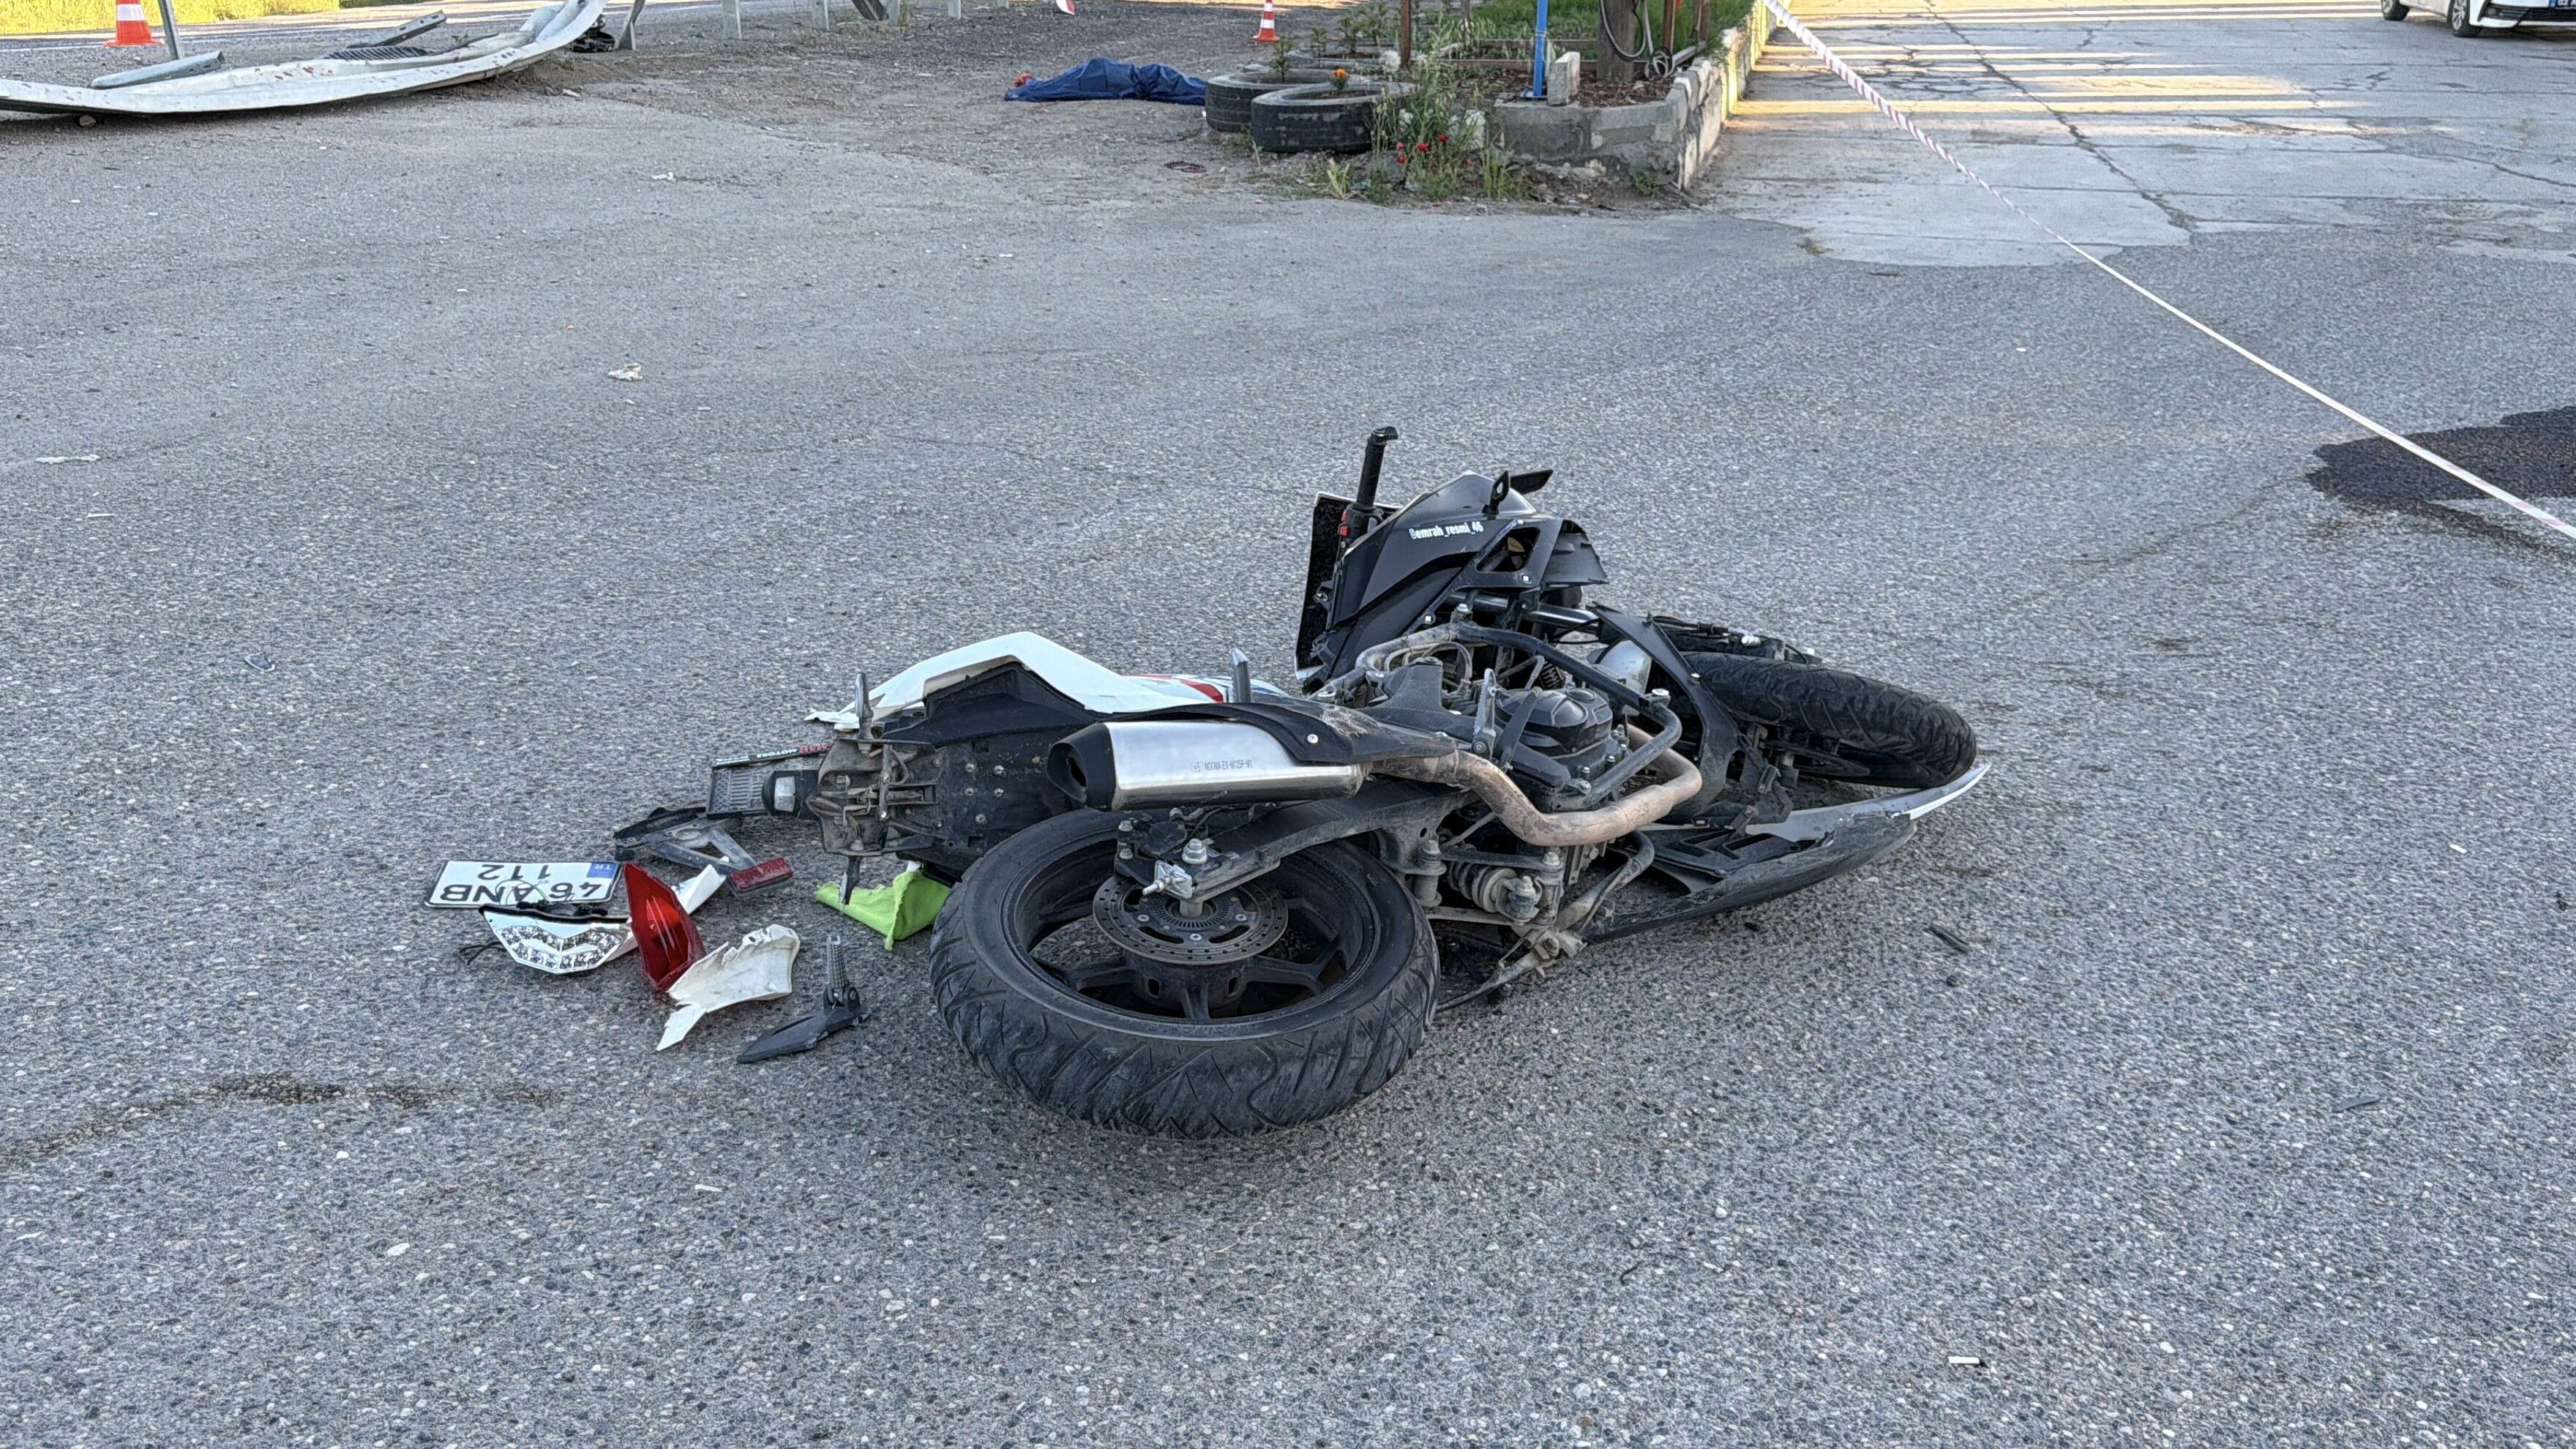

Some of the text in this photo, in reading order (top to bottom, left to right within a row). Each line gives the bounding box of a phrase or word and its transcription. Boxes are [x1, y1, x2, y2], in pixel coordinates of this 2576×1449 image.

[477, 864, 551, 880] 112
[440, 882, 602, 902] 46 ANB
